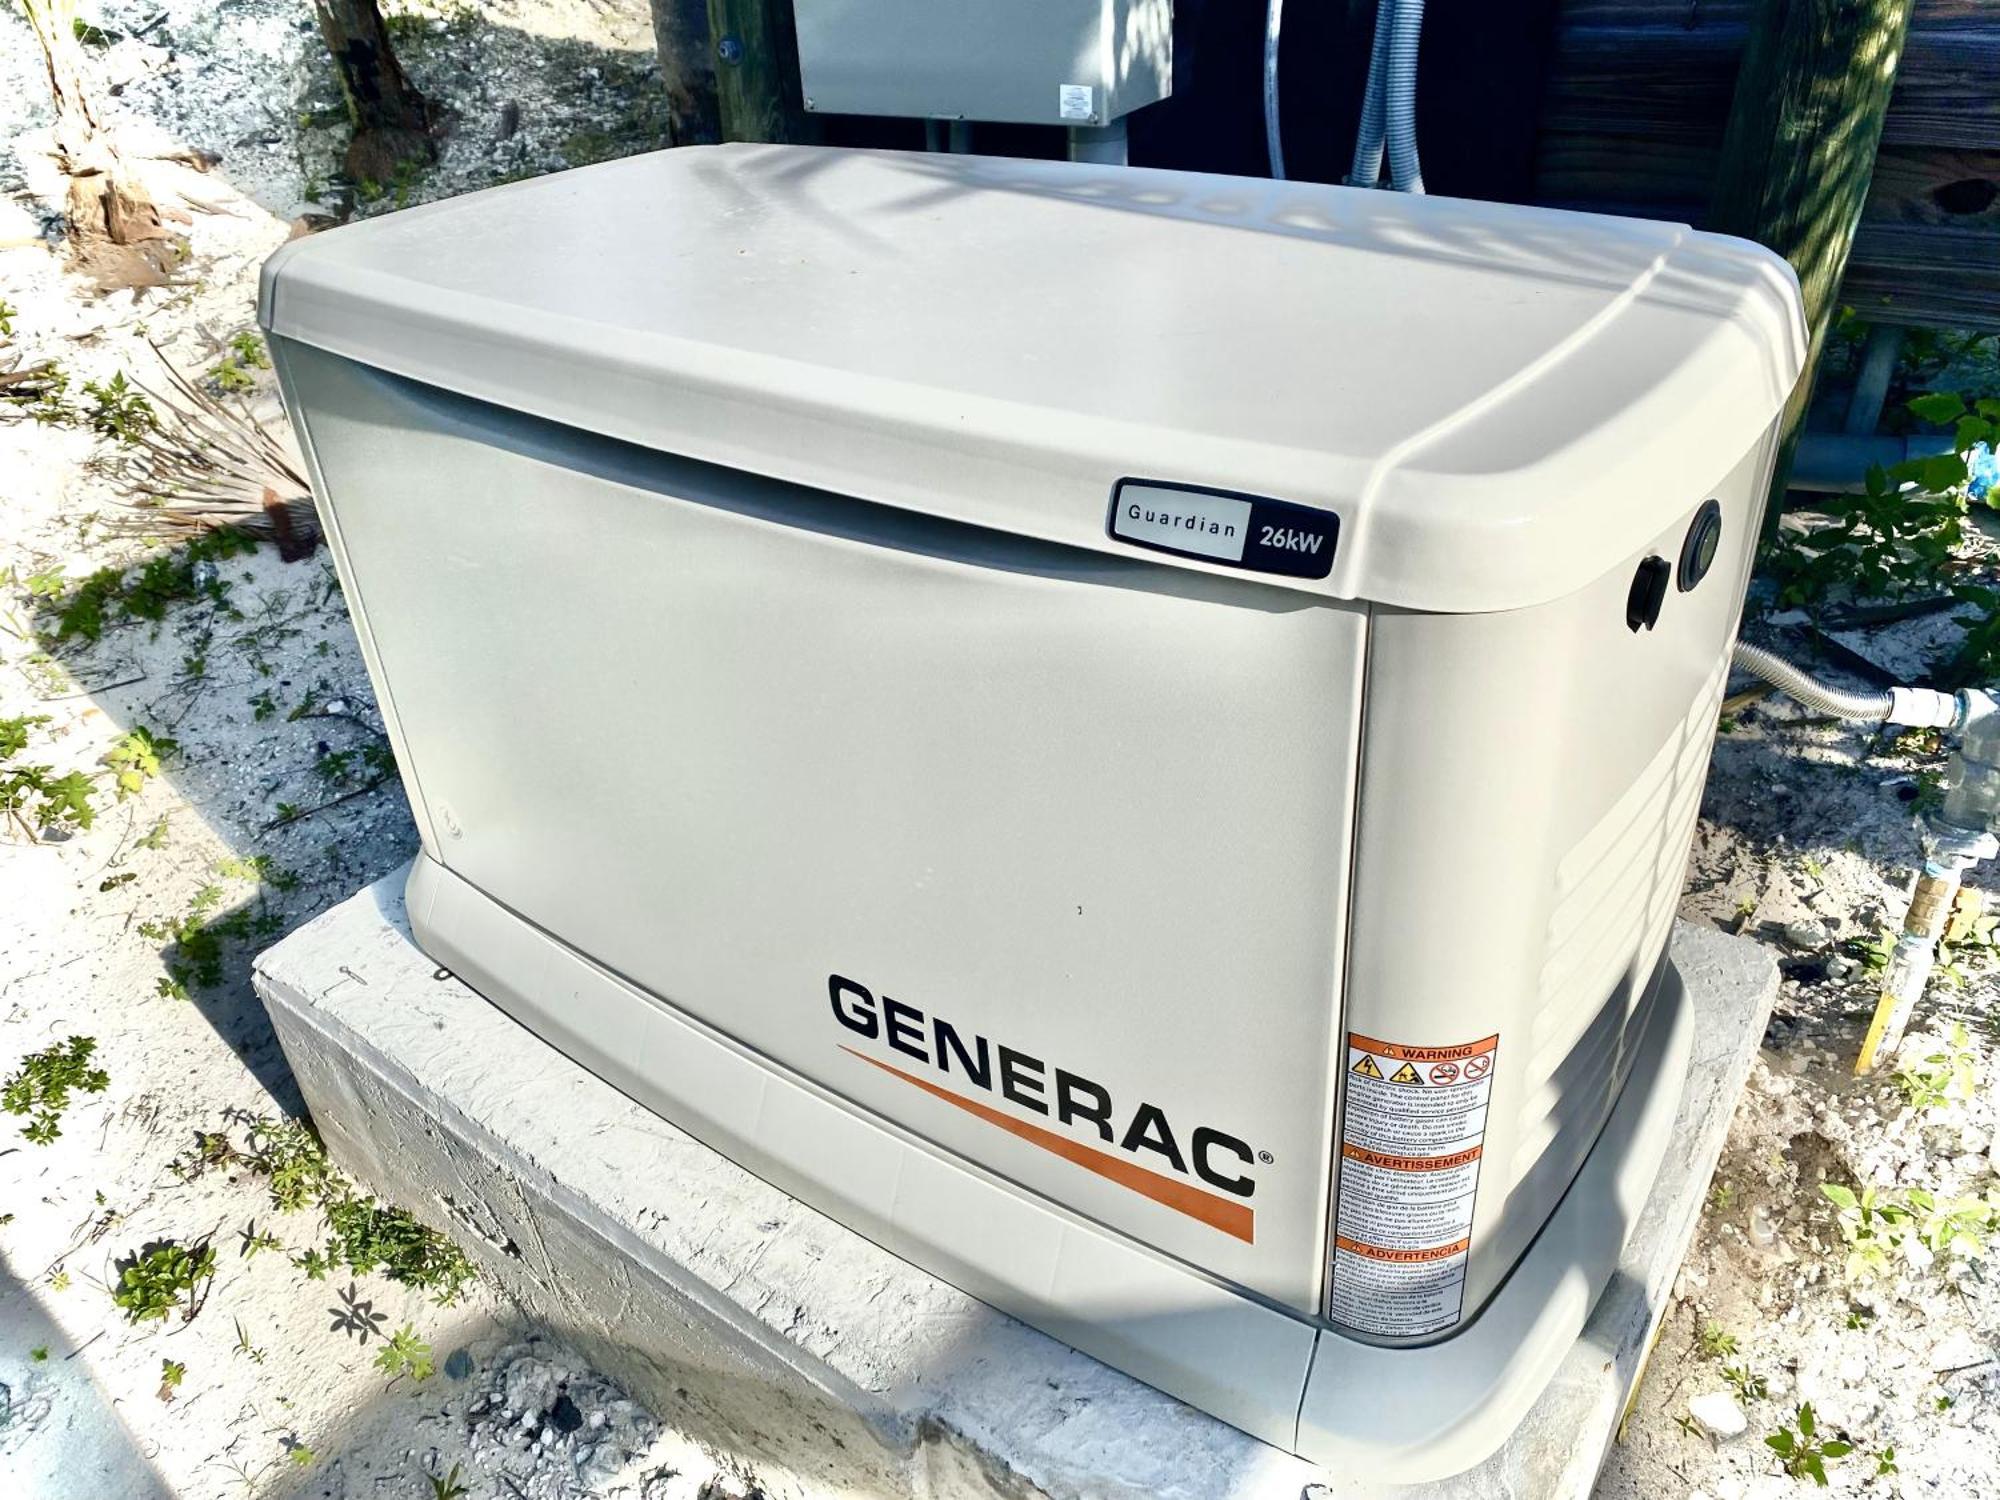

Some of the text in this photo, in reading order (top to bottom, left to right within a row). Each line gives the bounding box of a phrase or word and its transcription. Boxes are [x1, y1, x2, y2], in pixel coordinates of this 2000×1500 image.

[1128, 504, 1324, 555] Guardian 26kW
[1402, 1046, 1473, 1060] WARNING
[1364, 1150, 1477, 1169] AVERTISSEMENT
[1366, 1244, 1460, 1261] ADVERTENCIA
